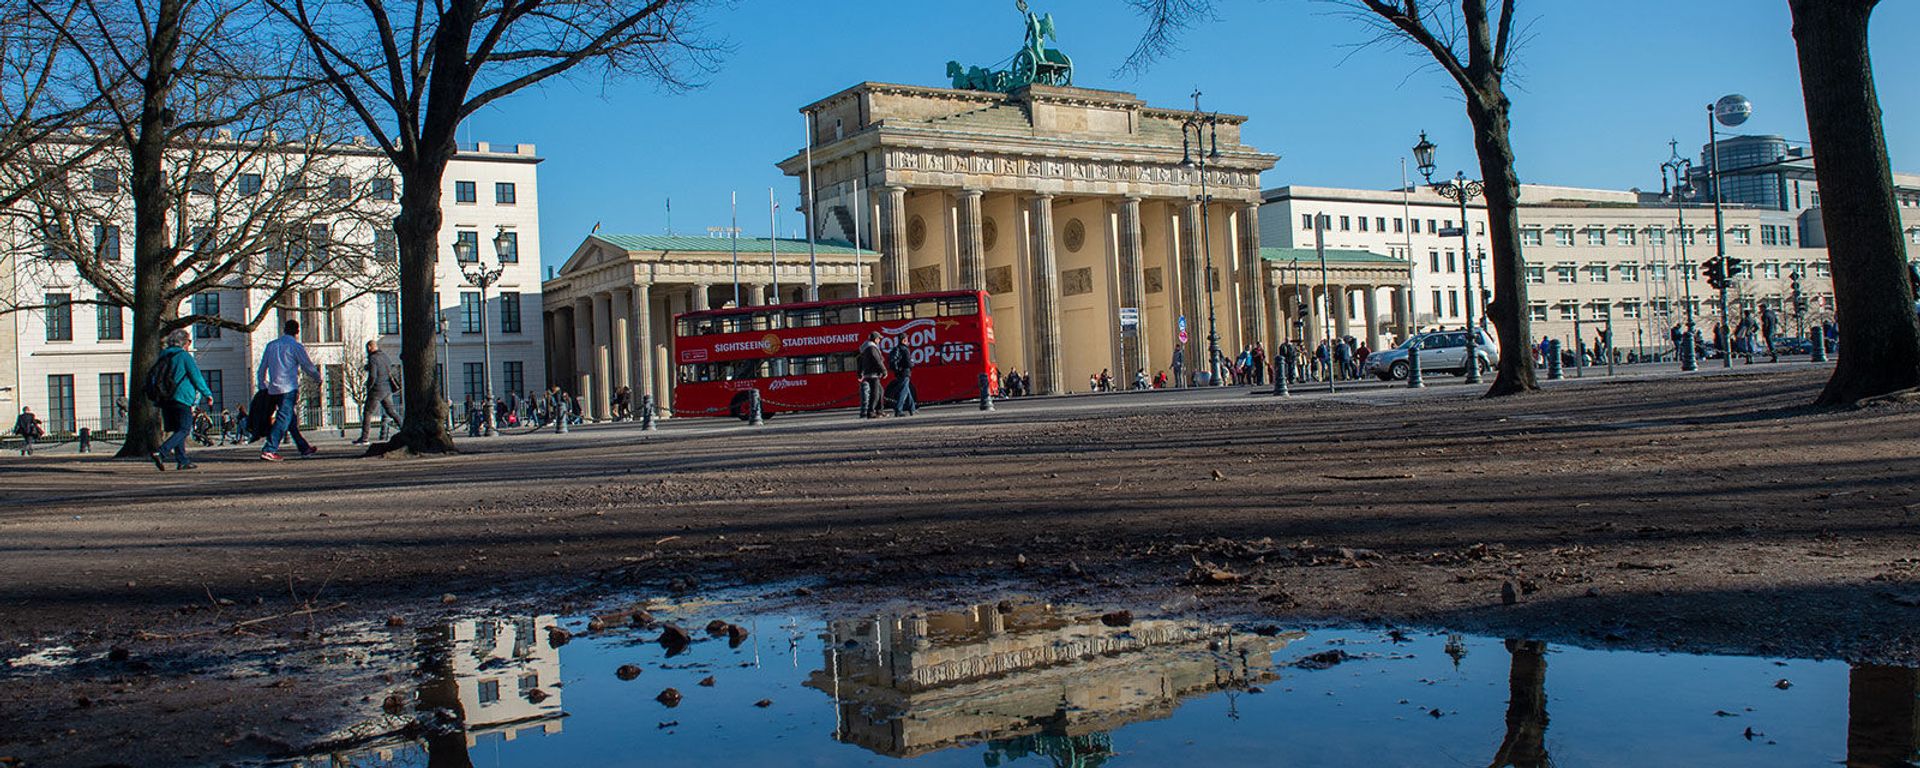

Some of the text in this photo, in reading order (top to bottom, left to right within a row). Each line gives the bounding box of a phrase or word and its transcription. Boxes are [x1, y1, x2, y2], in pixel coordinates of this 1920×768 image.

[714, 340, 771, 353] SIGHTSEEING
[782, 333, 860, 347] STADTRUNDFAHRT
[910, 327, 936, 347] ON
[911, 342, 975, 364] OP-OFF
